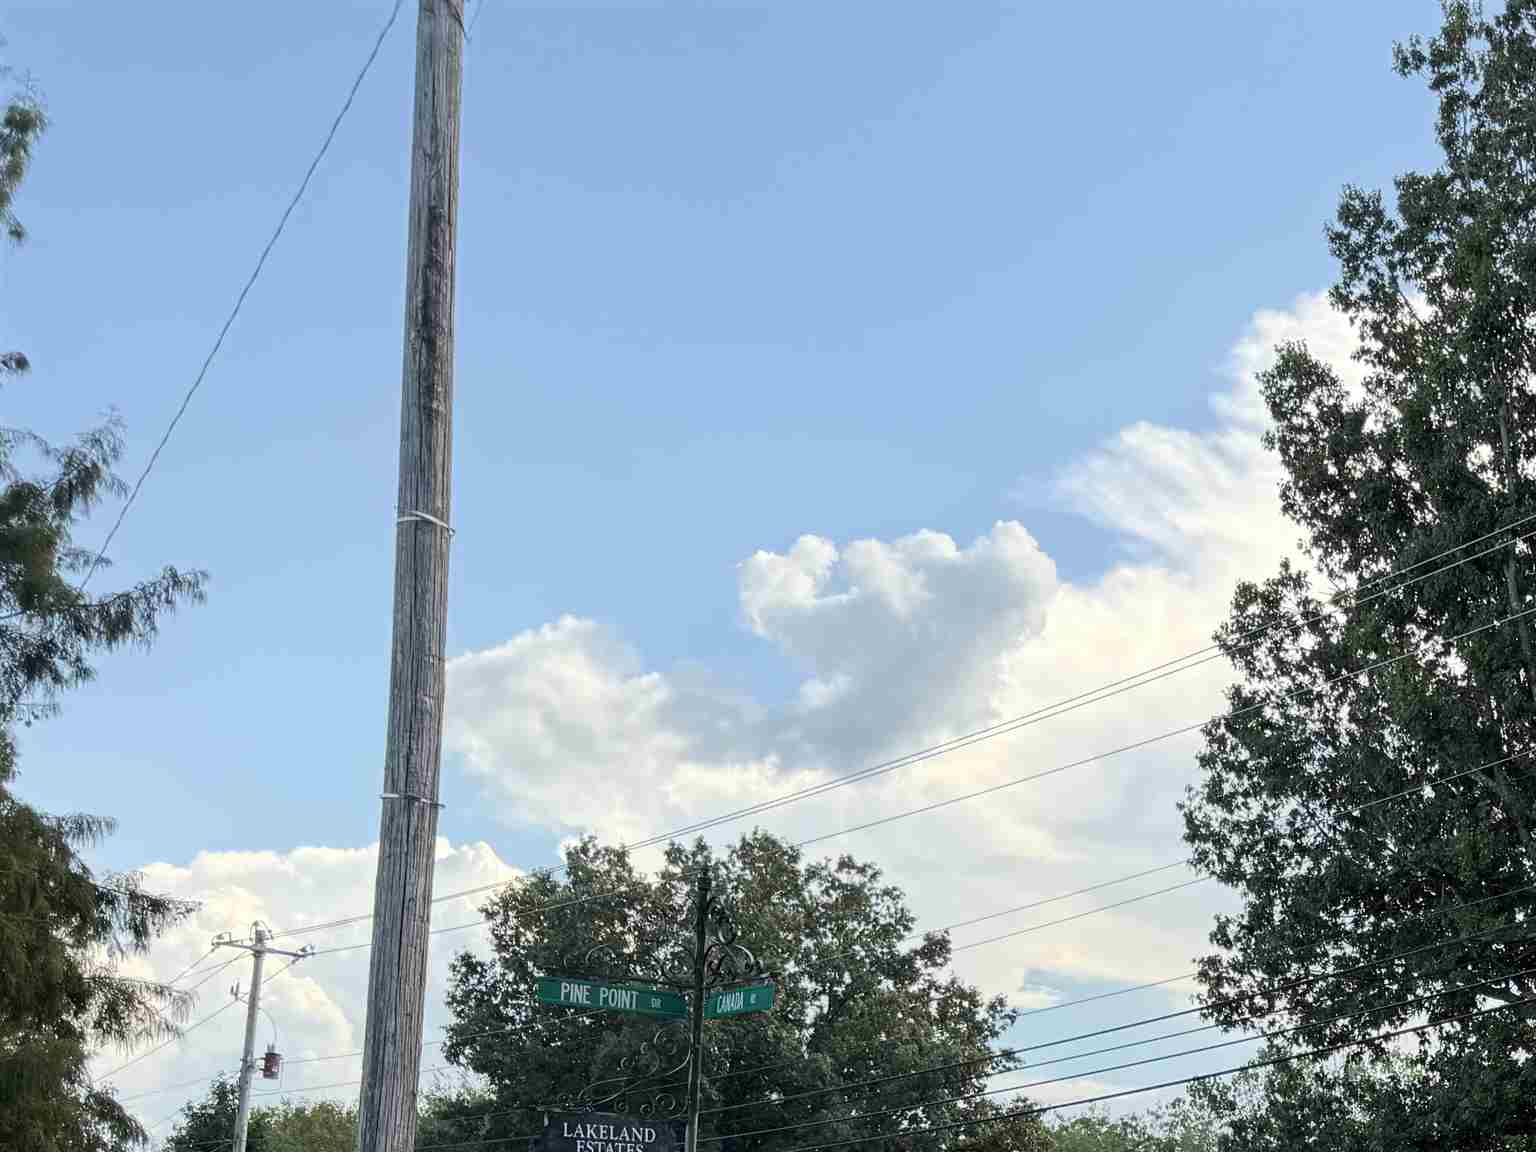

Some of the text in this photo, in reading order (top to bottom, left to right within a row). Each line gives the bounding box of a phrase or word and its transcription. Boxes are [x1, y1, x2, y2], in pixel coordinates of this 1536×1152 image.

[560, 982, 592, 1005] PINE
[599, 987, 639, 1010] POINT
[716, 991, 744, 1013] CANADA
[563, 1122, 656, 1143] LAKELAND
